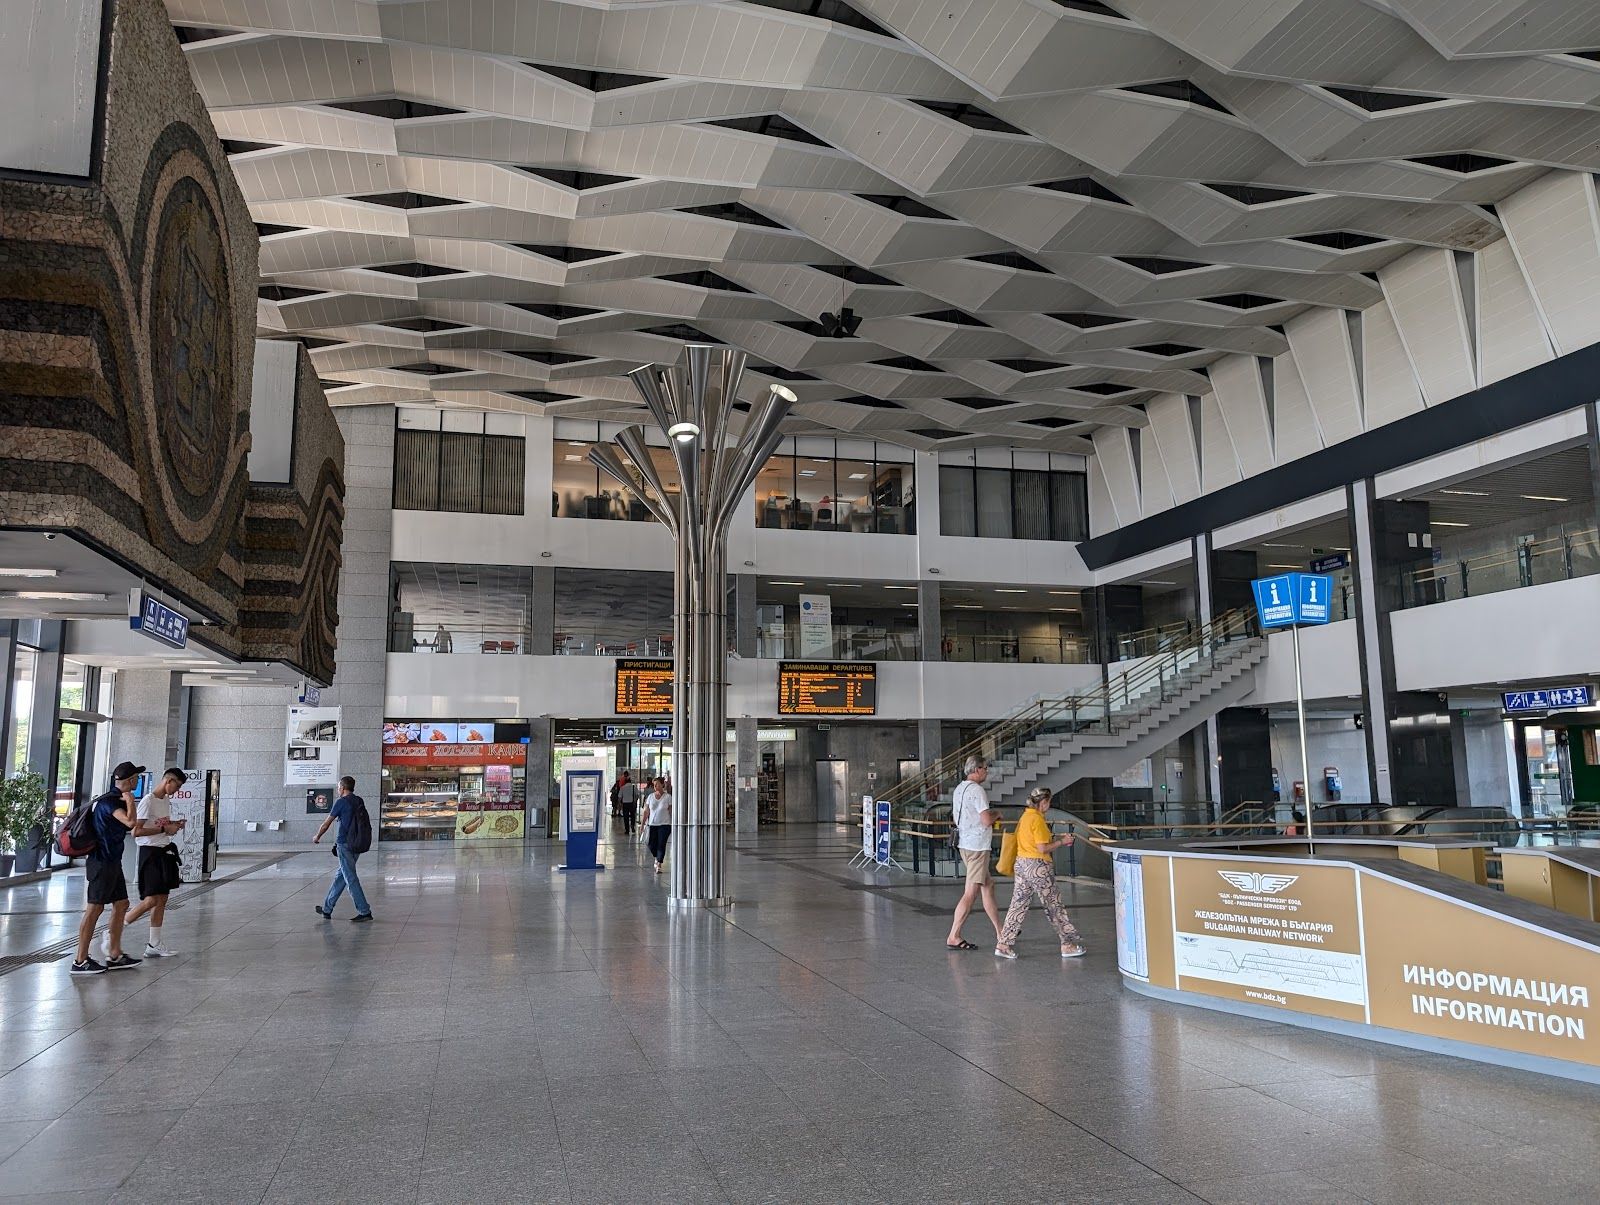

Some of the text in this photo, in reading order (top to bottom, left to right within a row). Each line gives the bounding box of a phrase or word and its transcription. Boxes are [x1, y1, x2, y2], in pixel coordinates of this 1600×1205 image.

[624, 661, 671, 669] ПРИСТИГАЩИ
[488, 744, 526, 756] КАФЕ
[1236, 900, 1263, 908] PASSENGER
[1194, 909, 1334, 933] ЖЕЛЕЗОПЪТНА МРЕЖА В БЪЛГАРИЯ
[1204, 921, 1324, 943] BULGARIAN RAILWAY NETWORK
[1403, 964, 1589, 1008] ИНФОРМАЦИЯ
[1245, 990, 1287, 1004] www.bdz.bg
[1411, 994, 1585, 1040] INFORMATION
